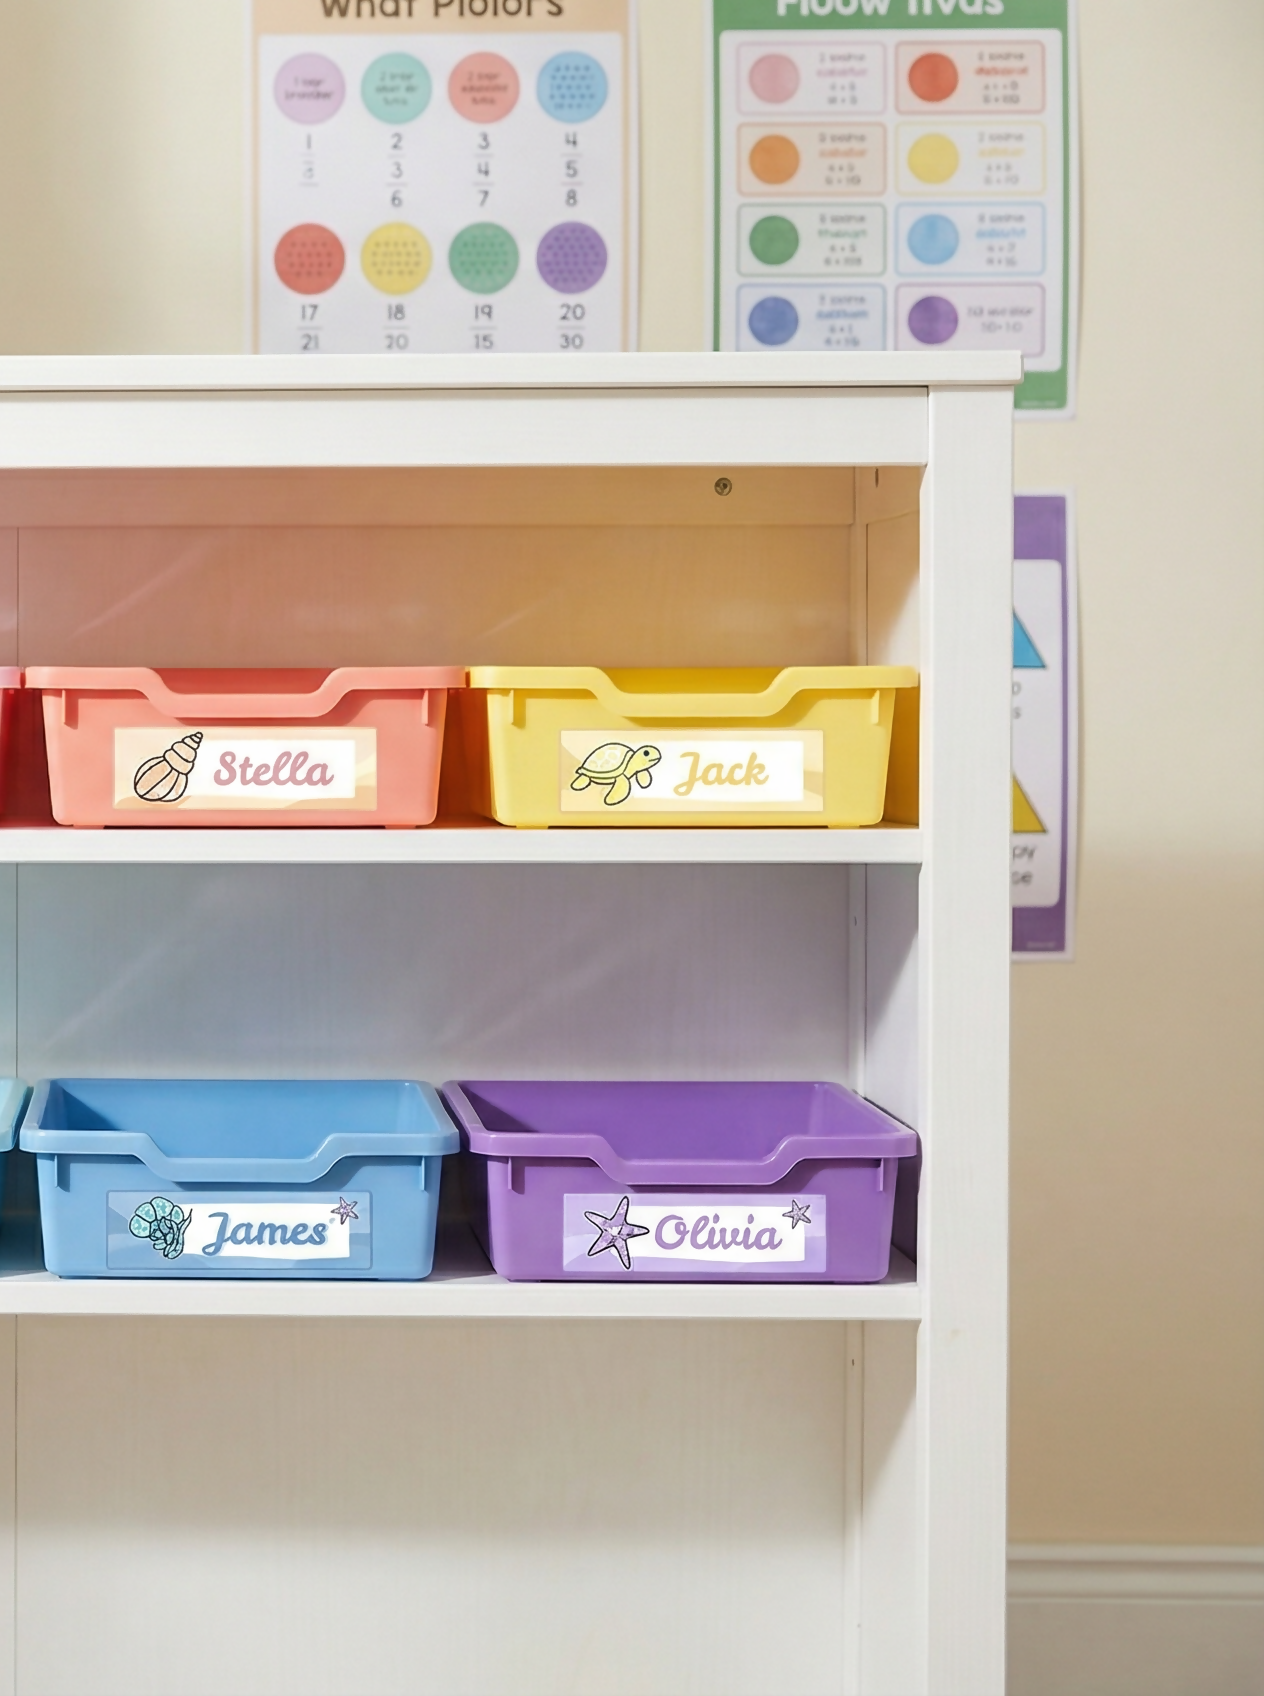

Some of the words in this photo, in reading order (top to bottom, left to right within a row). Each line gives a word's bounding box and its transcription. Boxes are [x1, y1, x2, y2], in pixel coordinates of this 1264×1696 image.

[391, 133, 403, 151] 2
[478, 133, 490, 151] 3
[564, 132, 578, 149] 4
[565, 161, 578, 178] 5
[390, 191, 403, 208] 6
[478, 190, 490, 207] 7
[300, 304, 318, 322] 17
[387, 304, 406, 322] 18
[474, 304, 493, 322] 19
[559, 304, 585, 321] 20
[474, 333, 494, 350] 15
[559, 333, 584, 350] 30
[214, 751, 334, 786] Stella
[673, 752, 769, 796] Jack
[202, 1211, 328, 1256] James
[654, 1214, 782, 1250] Olivia
